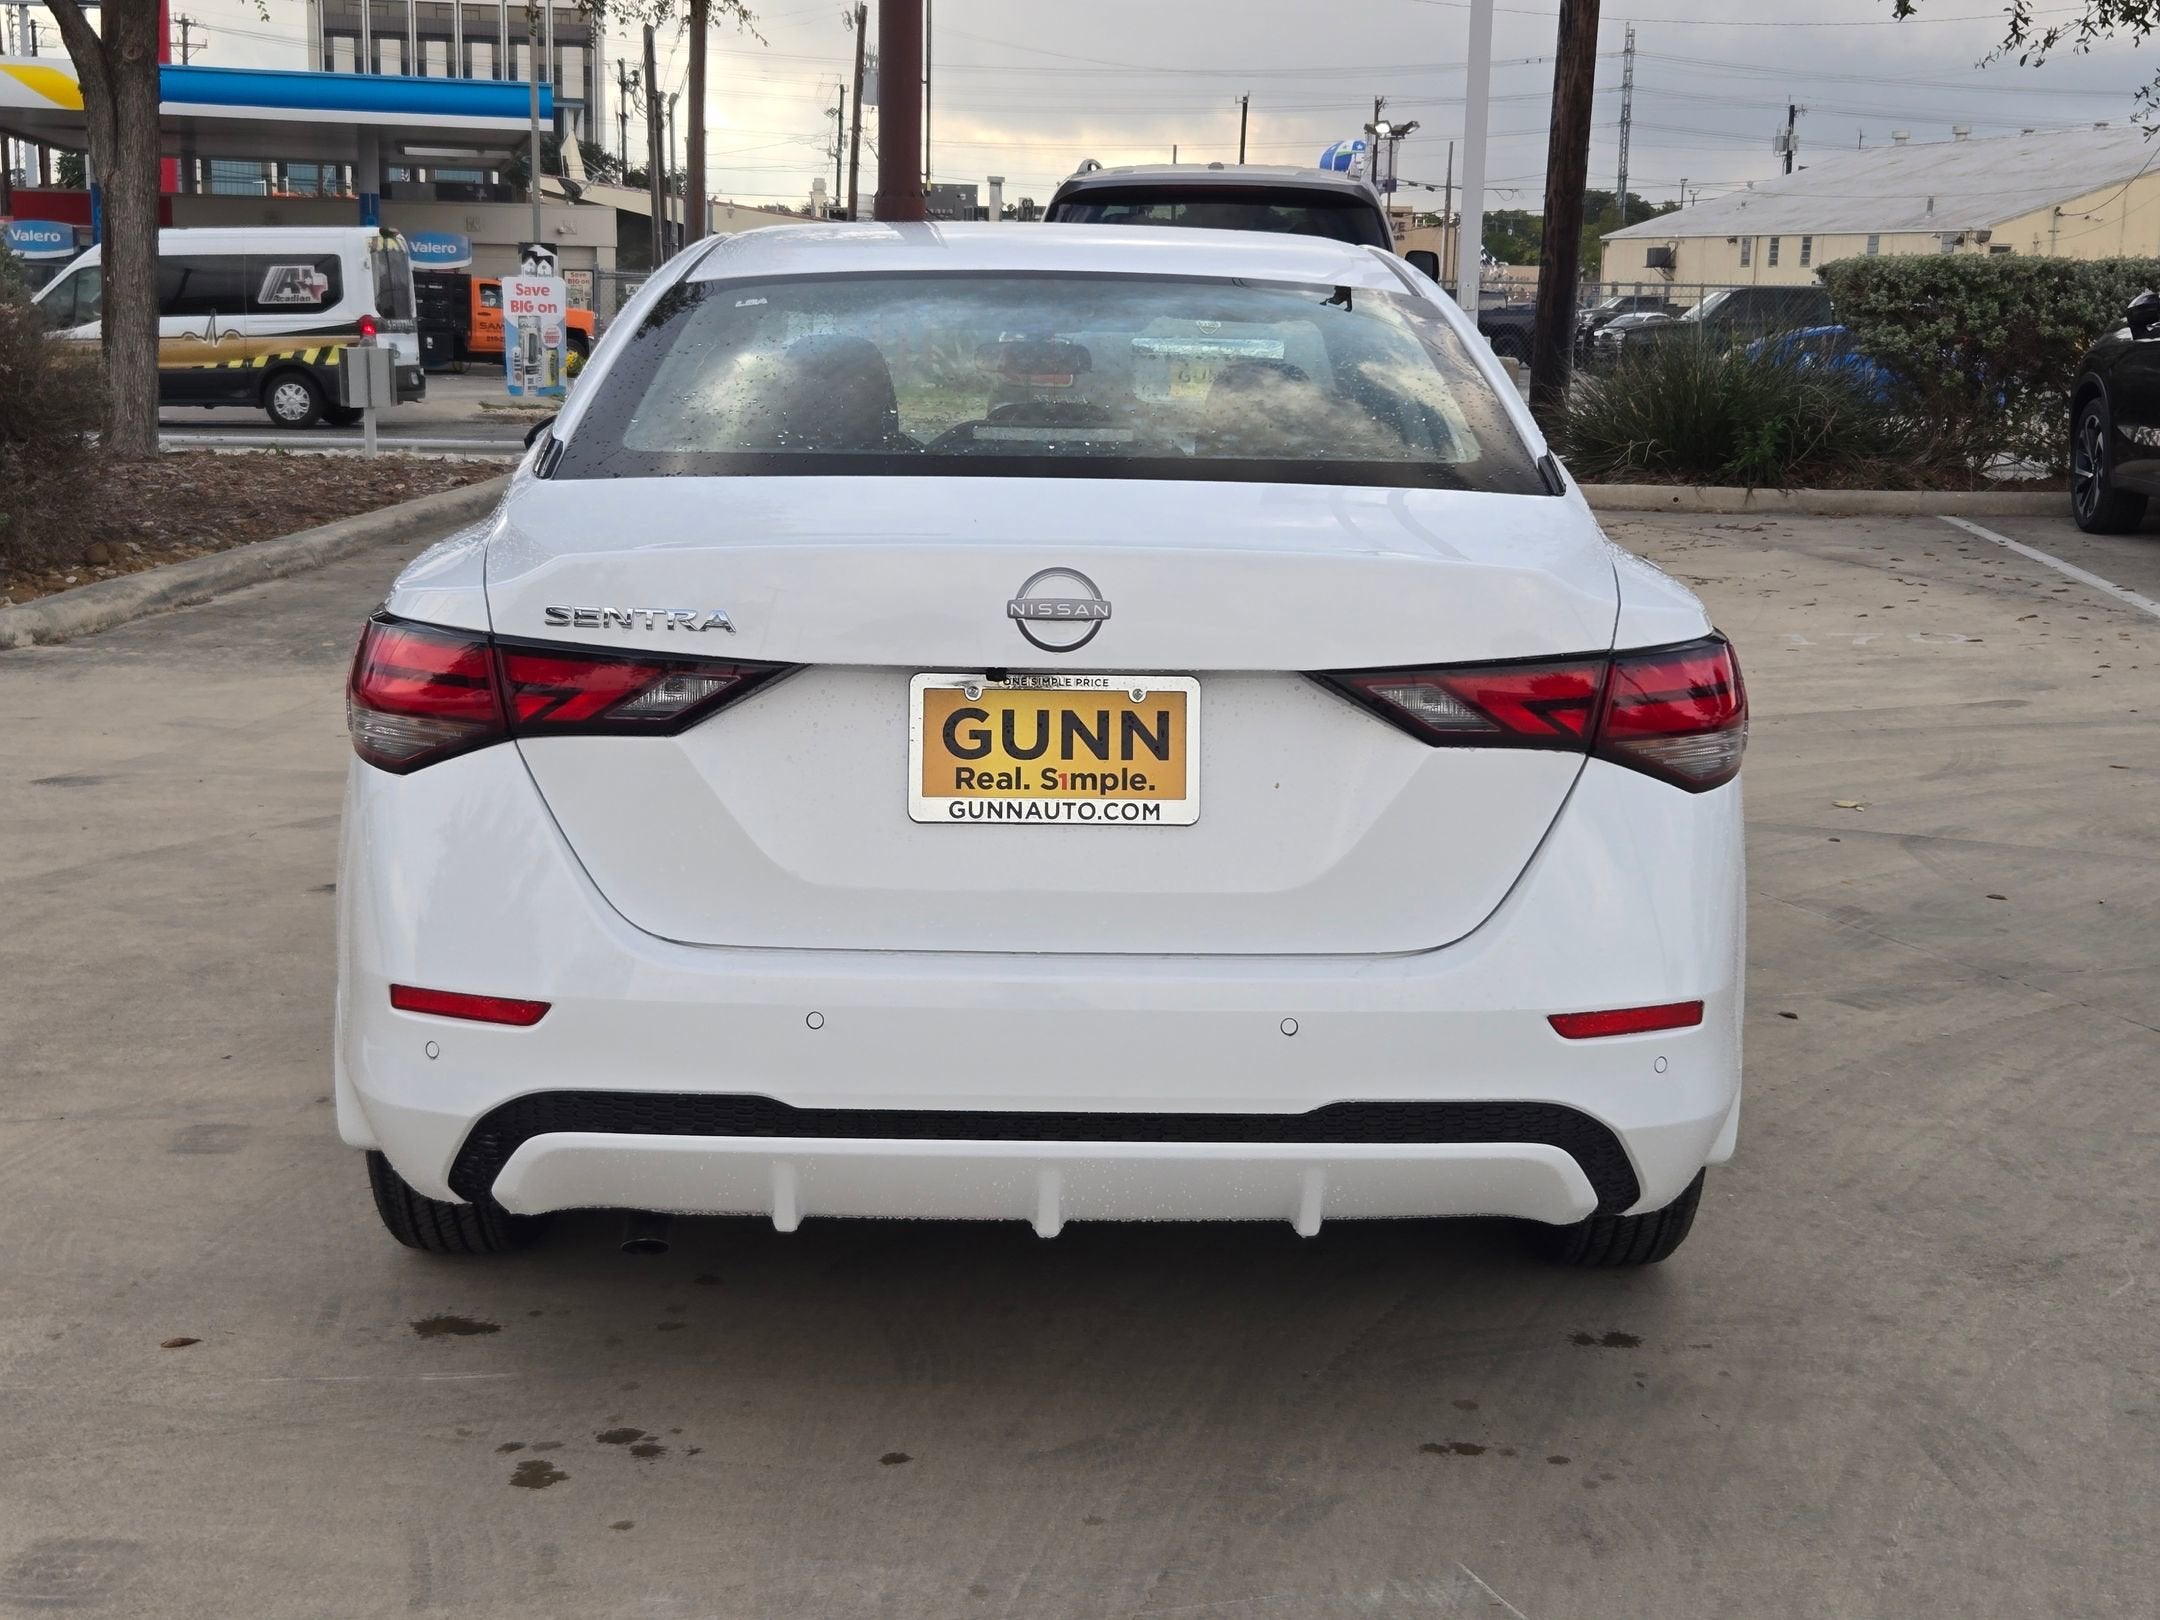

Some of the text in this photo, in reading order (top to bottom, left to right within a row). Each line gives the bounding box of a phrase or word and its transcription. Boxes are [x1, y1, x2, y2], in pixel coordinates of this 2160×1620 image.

[10, 229, 61, 242] Valero
[410, 241, 457, 254] Valero
[515, 283, 550, 297] Save
[510, 300, 558, 313] BIG on
[1009, 602, 1109, 618] NISSAN
[544, 604, 737, 633] SENTRA
[1003, 677, 1109, 687] ONE SIMPLE PRICE
[942, 707, 1170, 761] GUNN
[955, 766, 1156, 795] Real. S1mple.
[948, 800, 1161, 821] GUNNAUTO.COM
